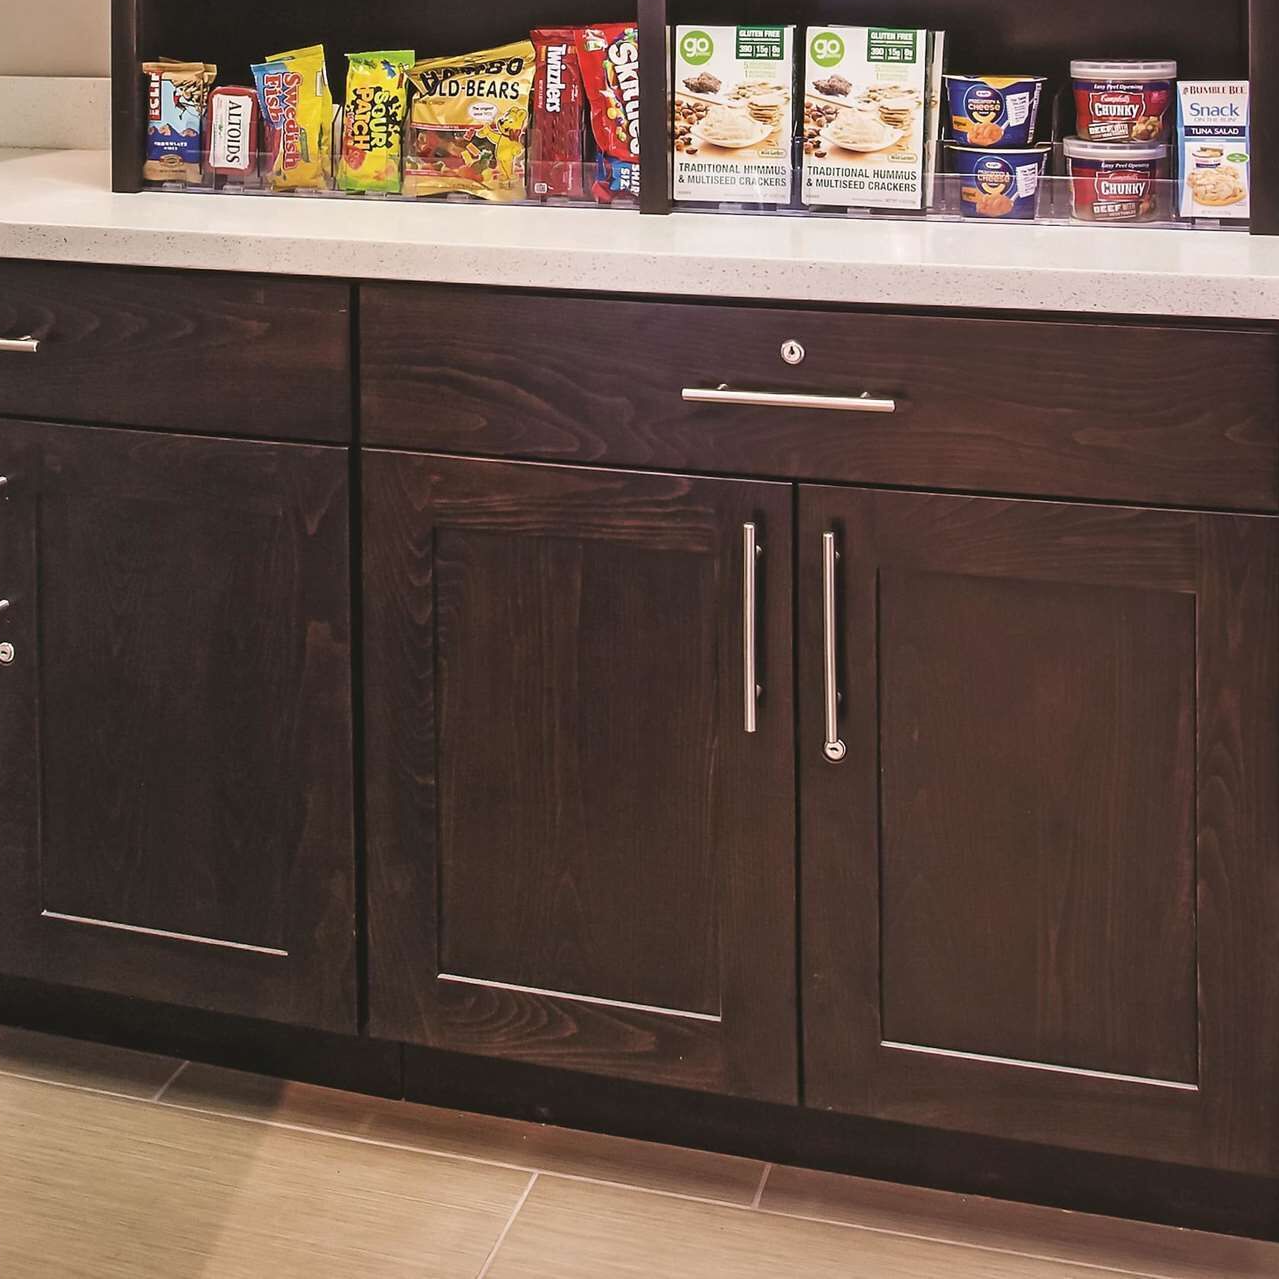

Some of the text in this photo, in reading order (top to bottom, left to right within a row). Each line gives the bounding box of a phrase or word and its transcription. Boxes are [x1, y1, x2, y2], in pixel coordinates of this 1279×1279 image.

[738, 29, 782, 38] GLUTEN FREE
[870, 31, 914, 41] GLUTEN FREE
[682, 36, 709, 58] go
[814, 38, 842, 62] go
[544, 43, 567, 114] Twizzlers
[263, 73, 286, 123] Fish
[1189, 84, 1247, 97] BUMBLE BEE
[1093, 103, 1140, 119] CHUNKY
[1189, 102, 1240, 118] Snack
[282, 71, 303, 170] Swedish
[351, 86, 372, 152] PATCH
[369, 90, 391, 150] SOUR
[225, 99, 243, 165] ALTOIDS
[1191, 127, 1240, 137] TUNA SALAD
[679, 161, 787, 177] TRADITIONAL HUMMUS
[807, 165, 918, 181] TRADITIONAL HUMMUS
[678, 174, 787, 188] & MULTISEED CRACKERS
[805, 177, 918, 193] & MULTISEED CRACKERS
[1100, 181, 1146, 197] CHUNKY
